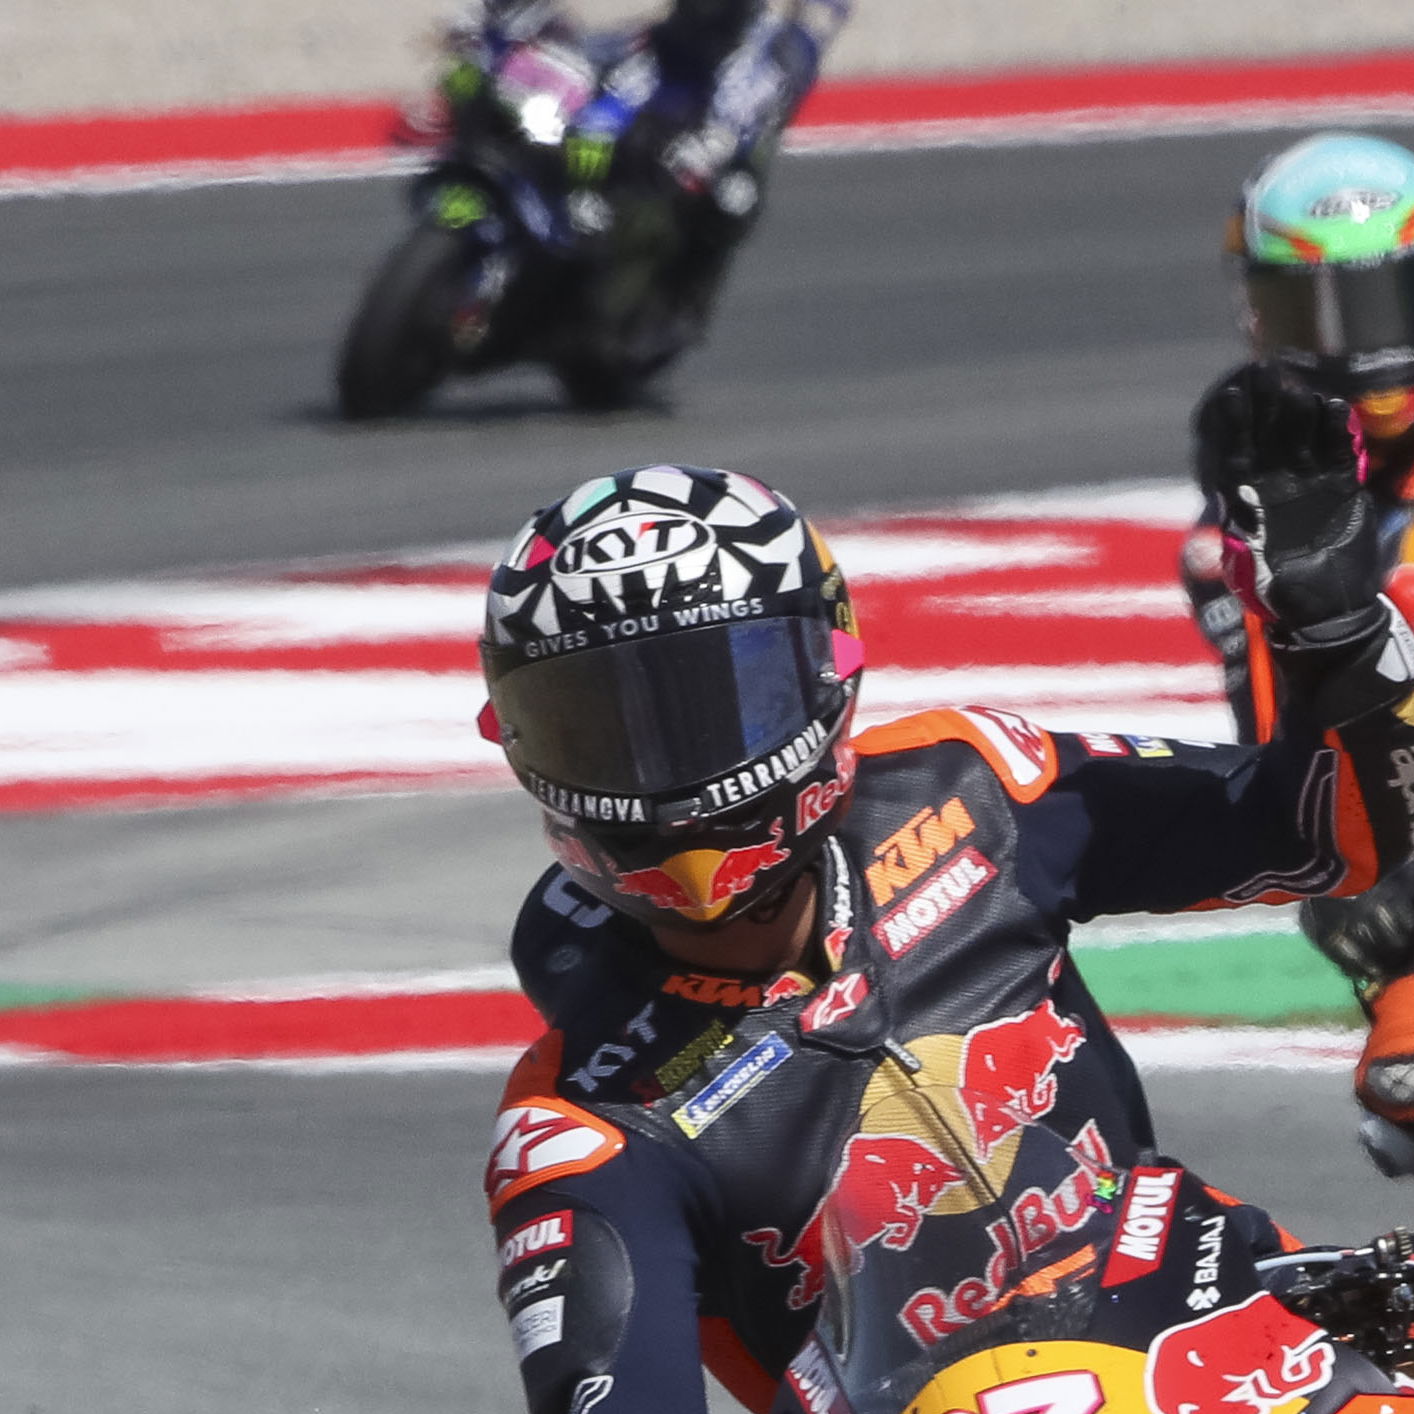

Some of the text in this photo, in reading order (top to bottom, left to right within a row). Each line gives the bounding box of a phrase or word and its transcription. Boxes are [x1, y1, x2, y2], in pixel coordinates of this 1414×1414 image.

[567, 518, 693, 573] KYT
[525, 630, 588, 658] GIVES
[603, 614, 660, 640] YOU
[528, 770, 647, 823] TERRANOVA
[704, 719, 829, 809] TERRANOVA
[864, 796, 976, 907] KTM
[881, 856, 988, 953] MOTUL
[661, 973, 762, 1008] KTM
[502, 1216, 568, 1268] OTUL
[1115, 1171, 1179, 1262] MOTUL
[1193, 1214, 1227, 1285] BAJAJ
[898, 1216, 1019, 1350] Red
